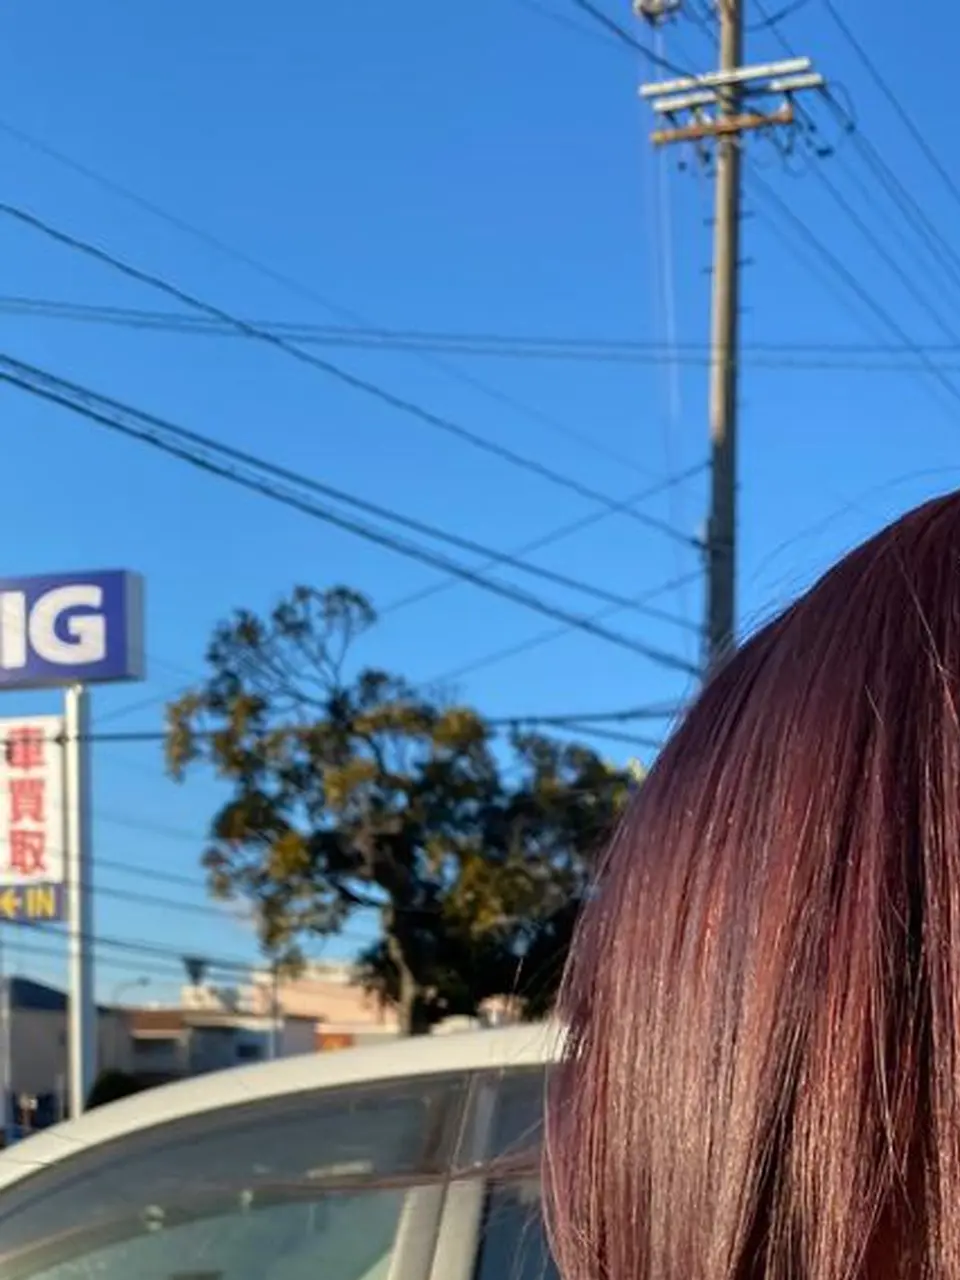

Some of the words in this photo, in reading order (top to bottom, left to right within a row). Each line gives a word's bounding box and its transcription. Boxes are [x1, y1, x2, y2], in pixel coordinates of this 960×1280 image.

[9, 727, 46, 875] 車買取
[26, 887, 56, 918] IN
